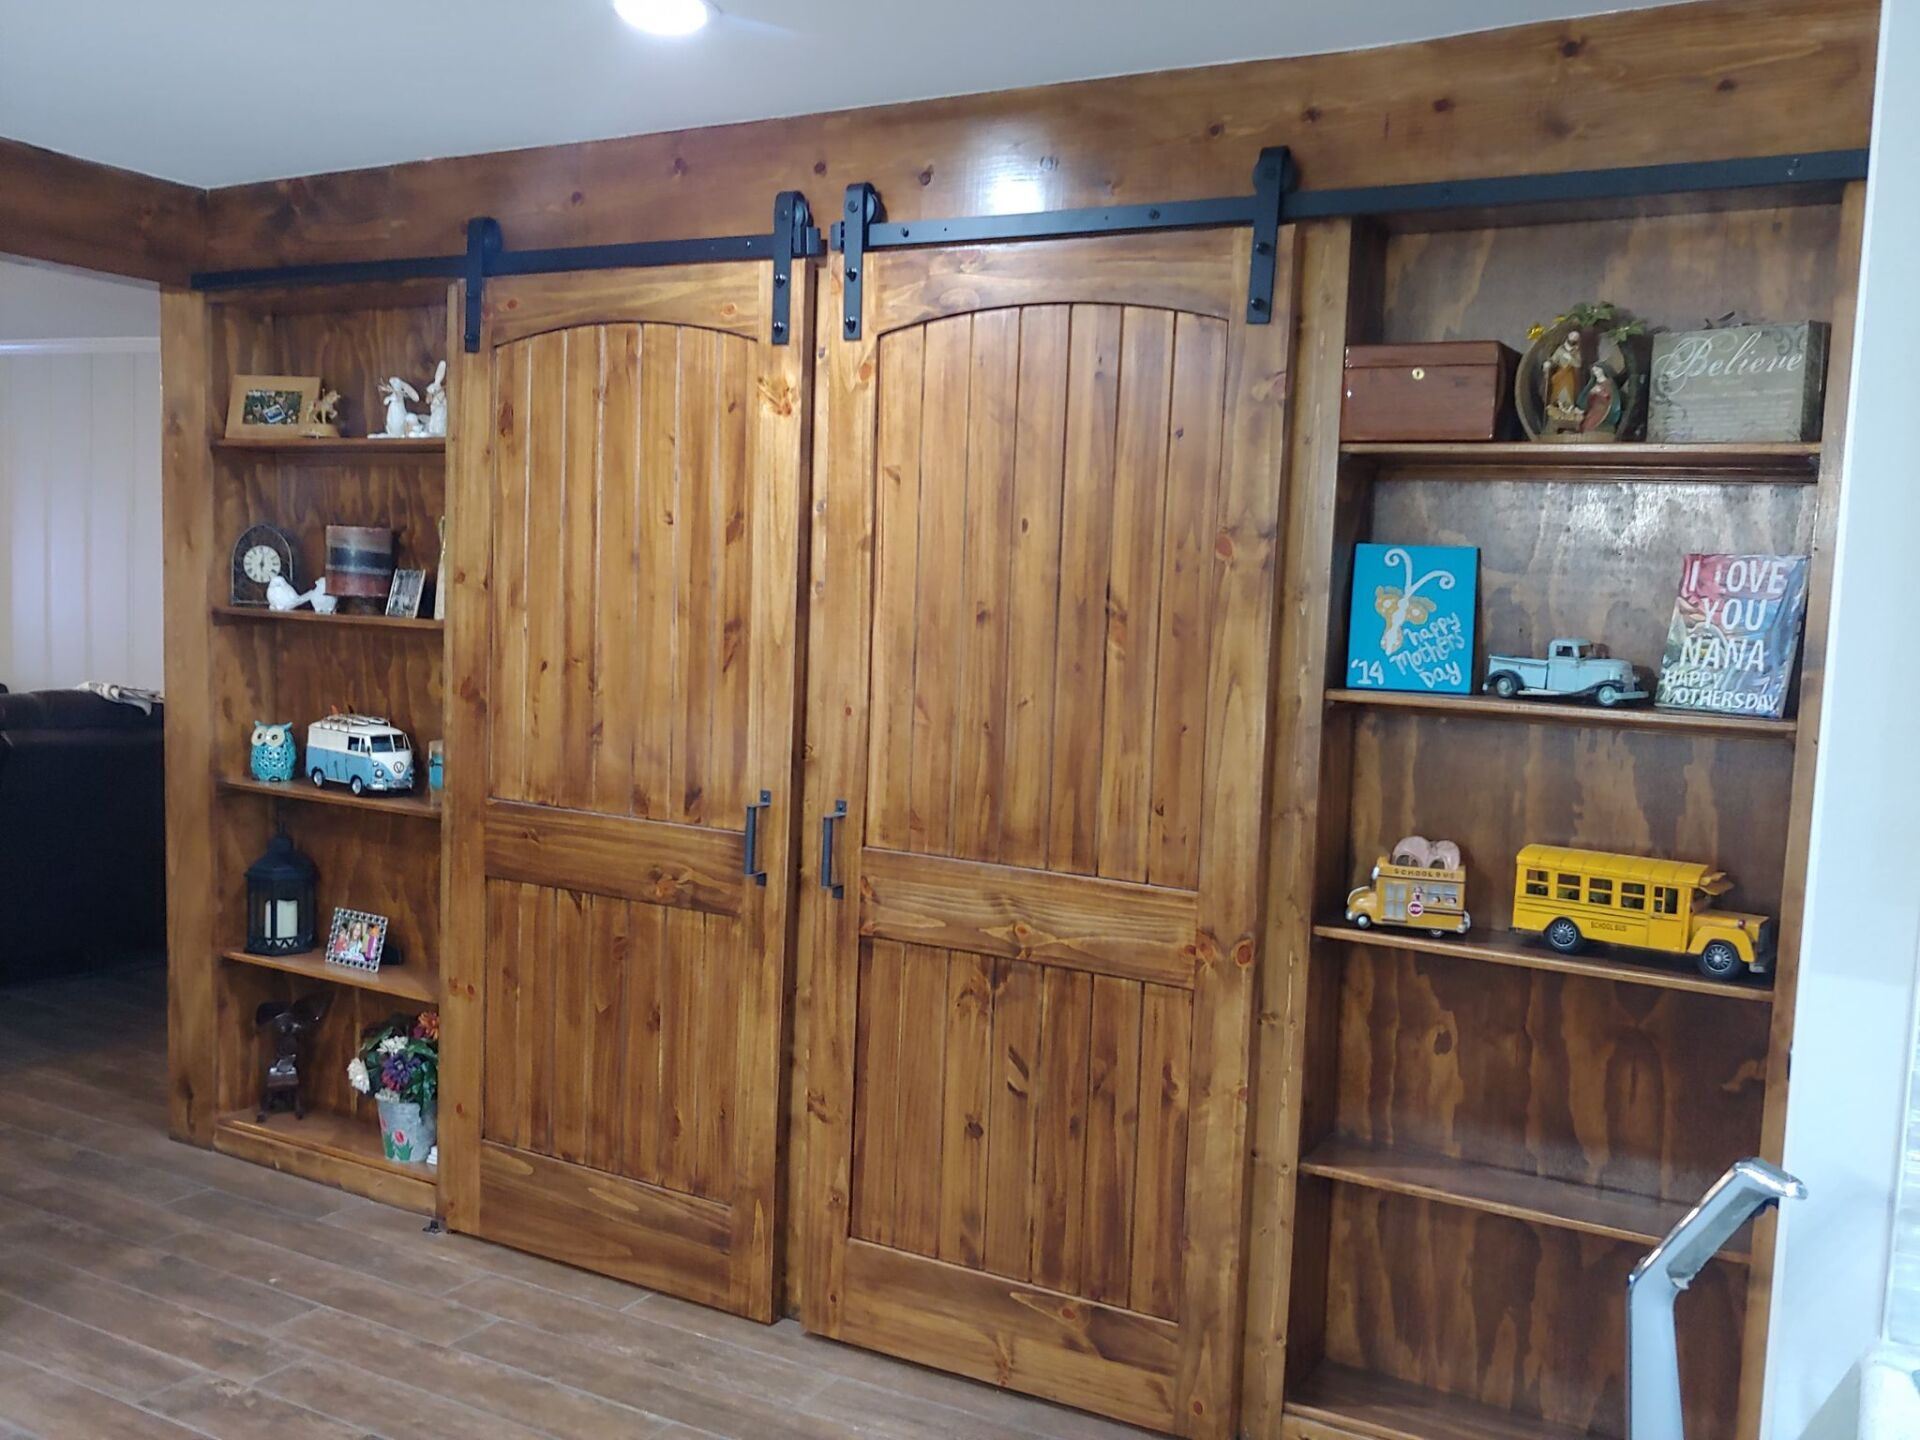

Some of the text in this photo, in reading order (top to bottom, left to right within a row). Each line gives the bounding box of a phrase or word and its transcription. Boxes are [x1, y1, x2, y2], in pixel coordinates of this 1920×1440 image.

[1652, 330, 1802, 396] Believe
[1689, 560, 1788, 594] I LOVE
[1702, 599, 1767, 631] YOU
[1679, 637, 1765, 673] NANA
[1663, 671, 1726, 691] HAPPY
[1394, 867, 1433, 878] SCHOOL
